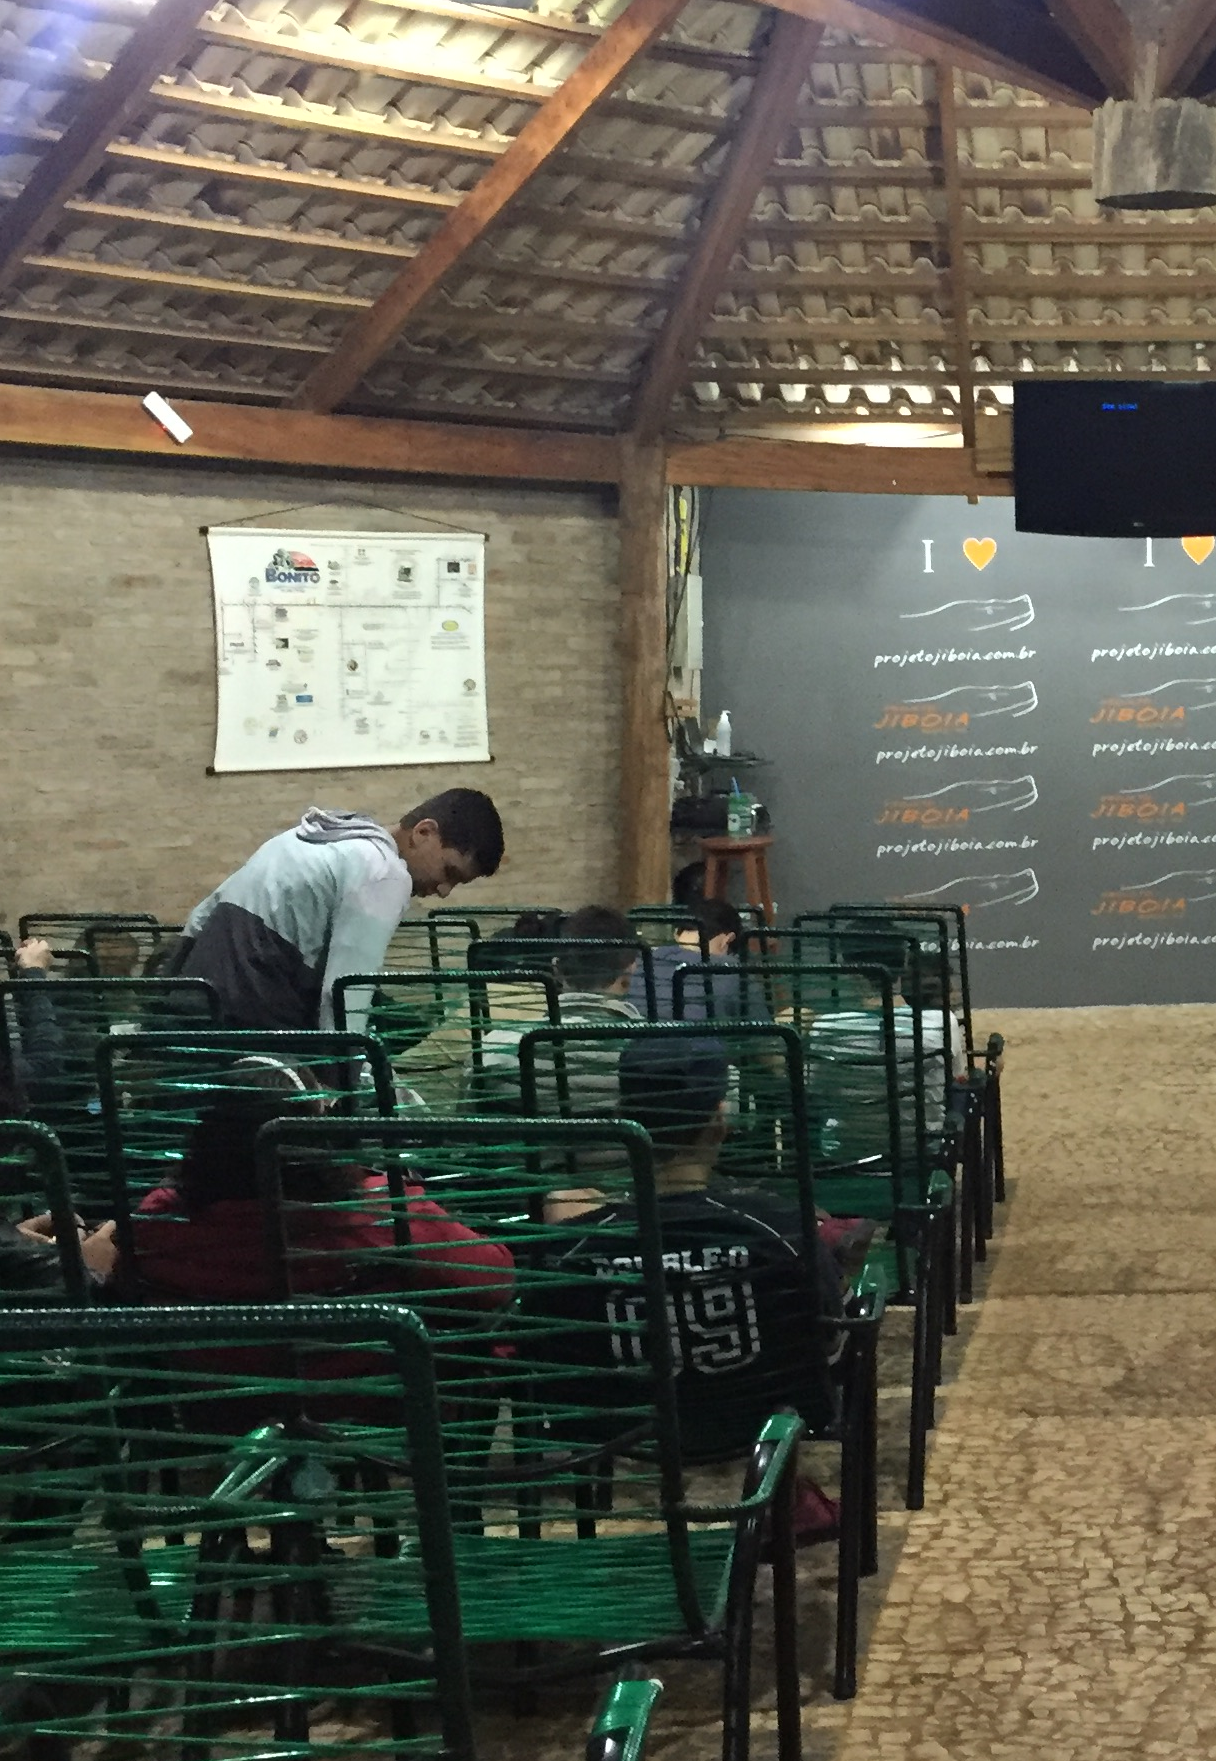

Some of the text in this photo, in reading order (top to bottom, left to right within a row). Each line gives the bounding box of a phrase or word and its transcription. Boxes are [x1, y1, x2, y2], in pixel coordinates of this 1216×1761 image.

[873, 646, 1037, 669] projetojiboia.com.br
[874, 712, 970, 729] JIBOIA
[1089, 706, 1185, 724] JIBOIA
[876, 741, 1039, 764] projetojiboia.com.br
[875, 808, 971, 825] JIBOIA
[1090, 802, 1186, 819] JIBOIA
[876, 835, 1039, 858] projetojiboia.com.br
[1090, 898, 1187, 916] JIBOIA
